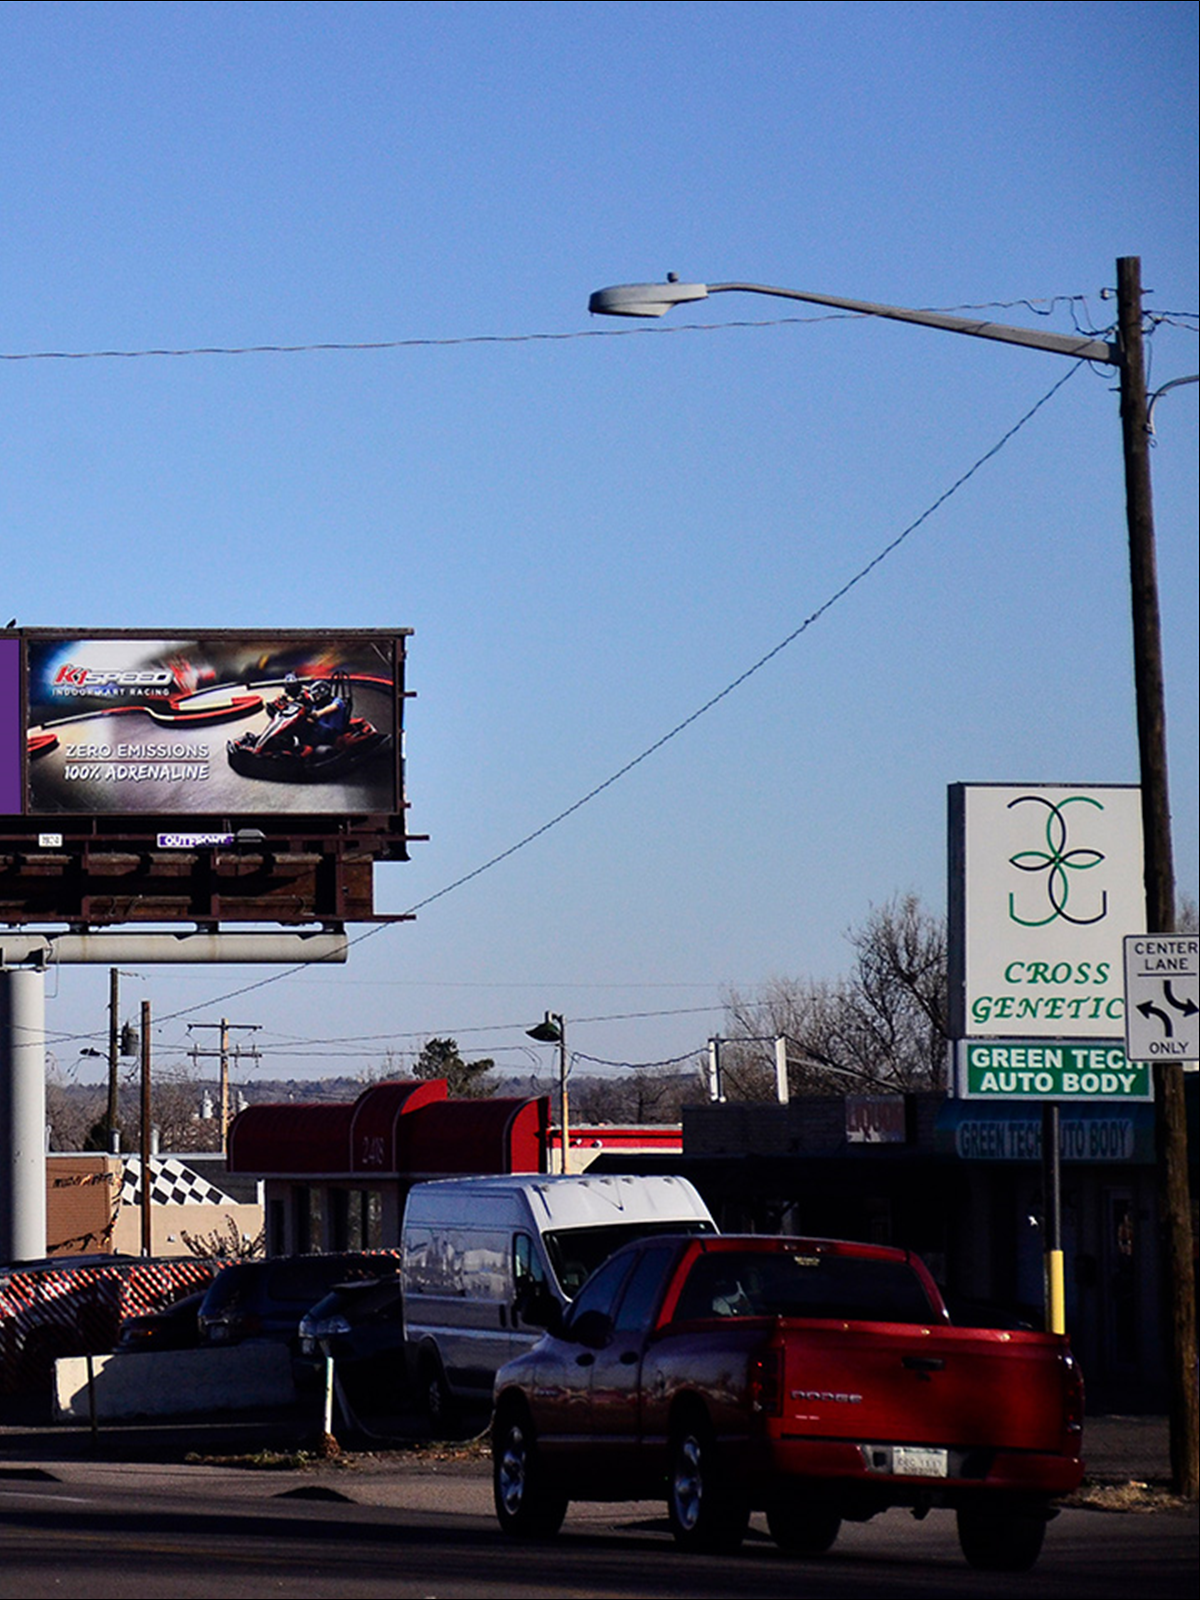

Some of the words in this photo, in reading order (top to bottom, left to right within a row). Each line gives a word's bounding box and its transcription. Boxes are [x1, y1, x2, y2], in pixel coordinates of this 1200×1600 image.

[52, 688, 94, 696] INDOOR
[129, 688, 170, 696] RACING
[65, 744, 112, 758] ZERO
[117, 744, 209, 758] EMISSIONS
[64, 765, 101, 780] 100%
[105, 765, 210, 781] ADRENALINE
[1135, 942, 1198, 954] CENTER
[1145, 958, 1189, 970] LANE
[1004, 962, 1110, 985] CROSS
[971, 996, 1125, 1024] GENETIC
[1149, 1042, 1189, 1054] ONLY
[971, 1049, 1063, 1068] GREEN
[1072, 1051, 1144, 1069] TECH
[980, 1072, 1054, 1092] AUTO
[1063, 1074, 1137, 1093] BODY
[960, 1122, 1006, 1158] GREEN
[1090, 1121, 1129, 1157] BODY
[791, 1390, 862, 1404] DODGE
